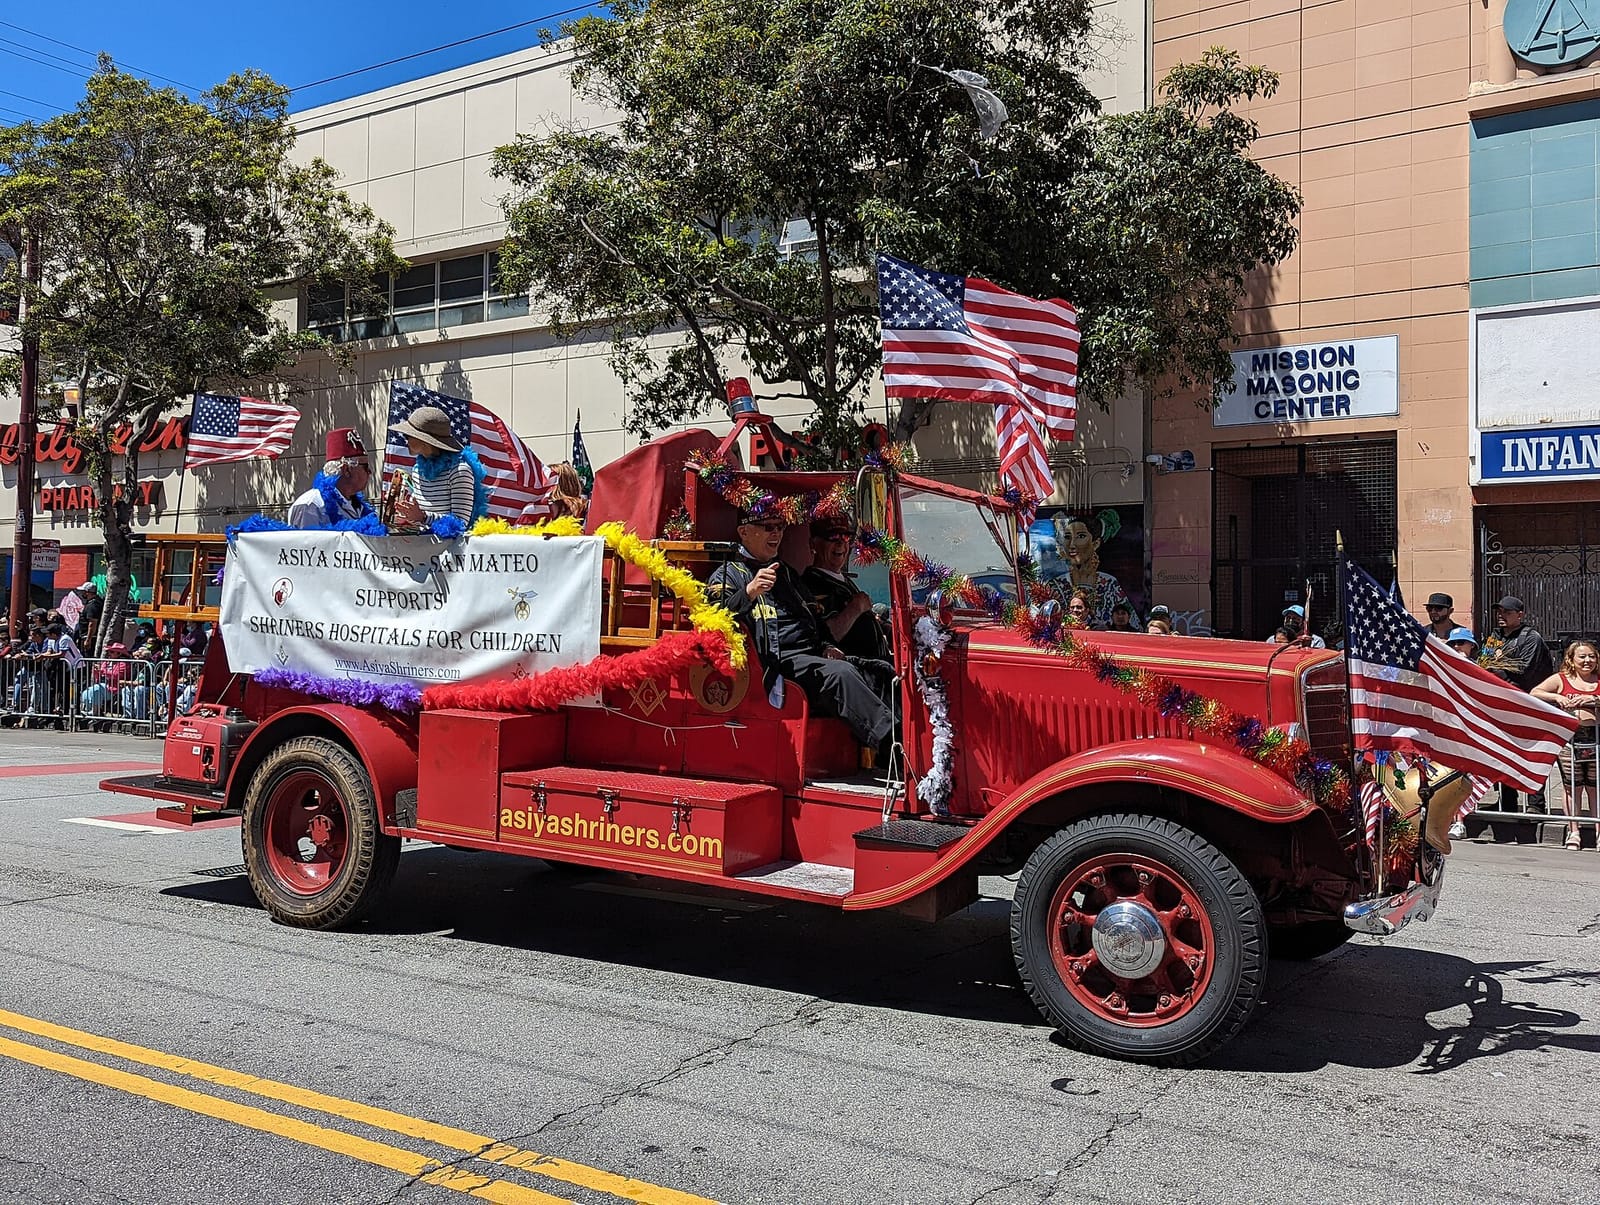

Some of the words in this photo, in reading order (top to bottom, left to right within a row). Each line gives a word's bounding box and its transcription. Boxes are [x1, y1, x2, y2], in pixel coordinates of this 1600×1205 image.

[1252, 345, 1355, 373] MISSION
[1246, 369, 1360, 397] MASONIC
[1254, 394, 1351, 419] CENTER
[277, 546, 329, 569] ASIYA
[333, 551, 415, 574] SHRINERS
[430, 553, 467, 573] SAN
[470, 553, 539, 573] MATEO
[355, 588, 444, 611] SUPPORTS
[249, 616, 325, 640] SHRINERS
[328, 623, 422, 648] HOSPITALS
[426, 630, 464, 651] FOR
[469, 630, 563, 654] CHILDREN
[500, 806, 723, 859] asiyashriners.com
